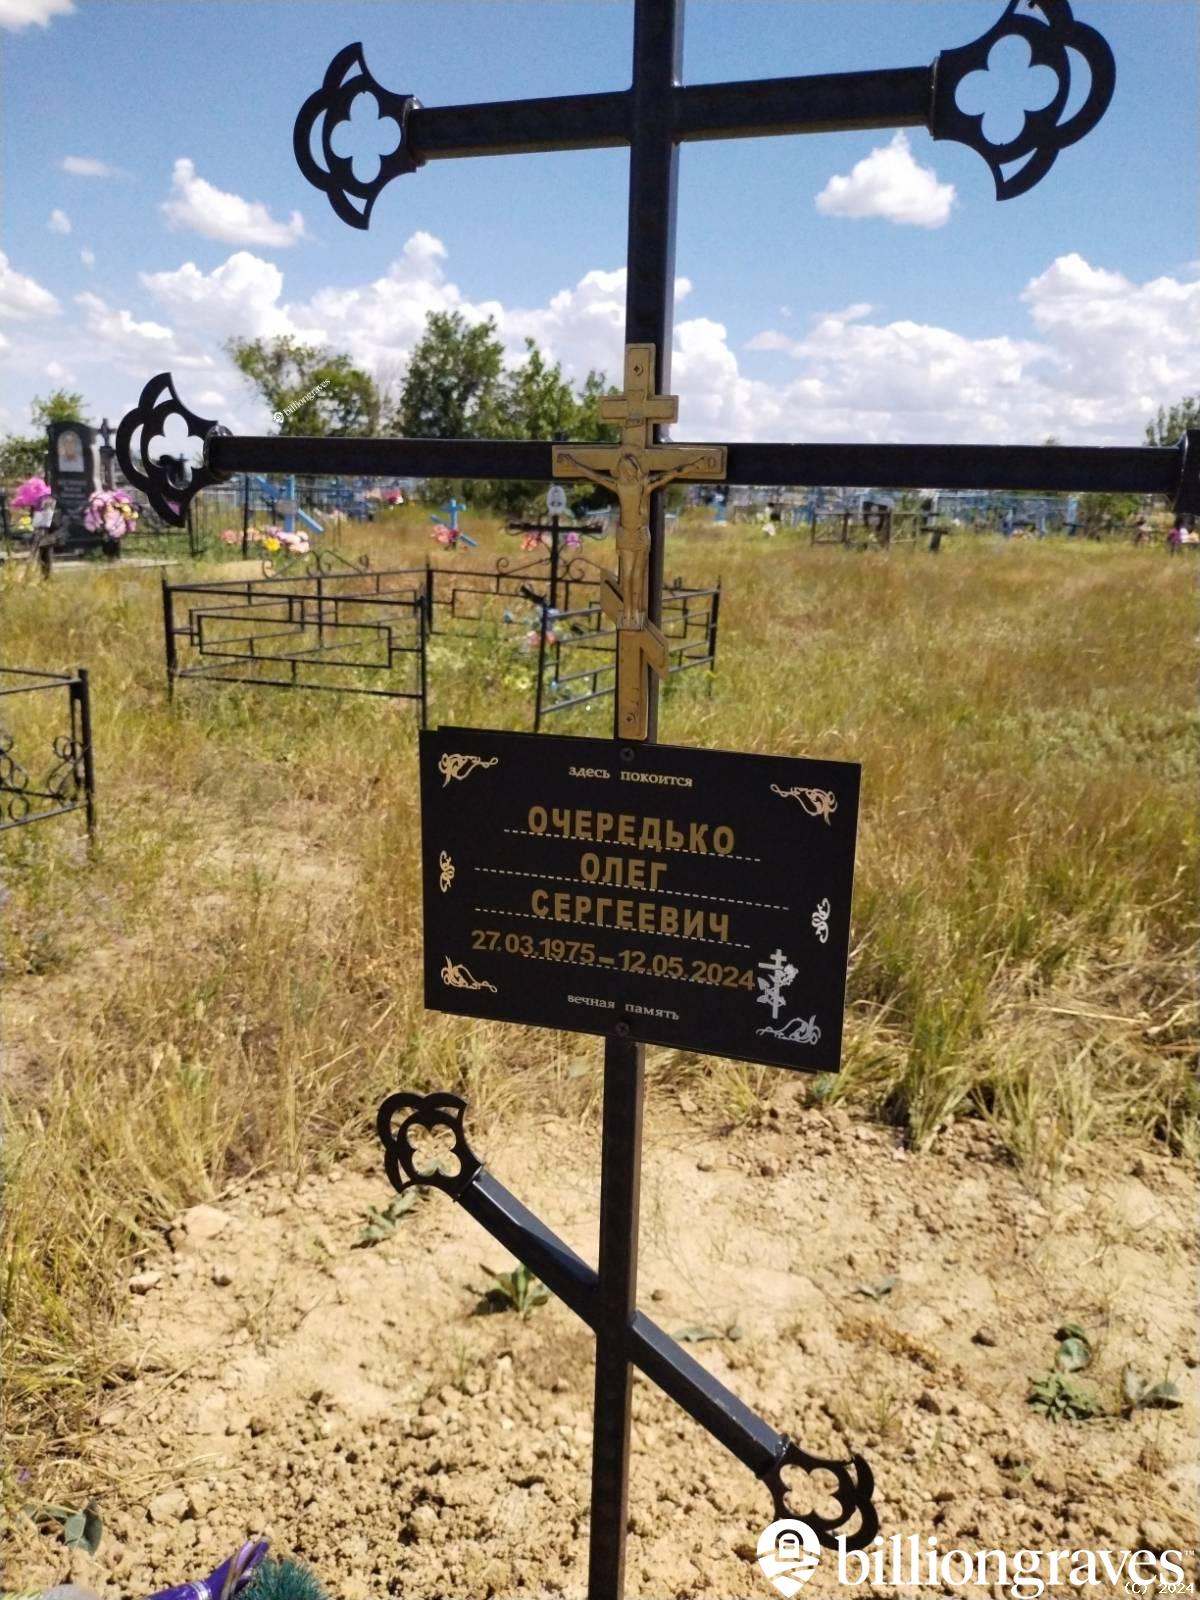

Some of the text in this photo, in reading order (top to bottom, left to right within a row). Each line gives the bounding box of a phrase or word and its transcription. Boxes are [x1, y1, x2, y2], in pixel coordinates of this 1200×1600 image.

[568, 766, 693, 787] здесь покоится
[528, 806, 736, 854] ОЧЕРЕДЬКО
[580, 852, 668, 890] ОЛЕГ
[531, 889, 730, 942] СЕРГЕЕВИЧ
[567, 994, 680, 1020] вечная память
